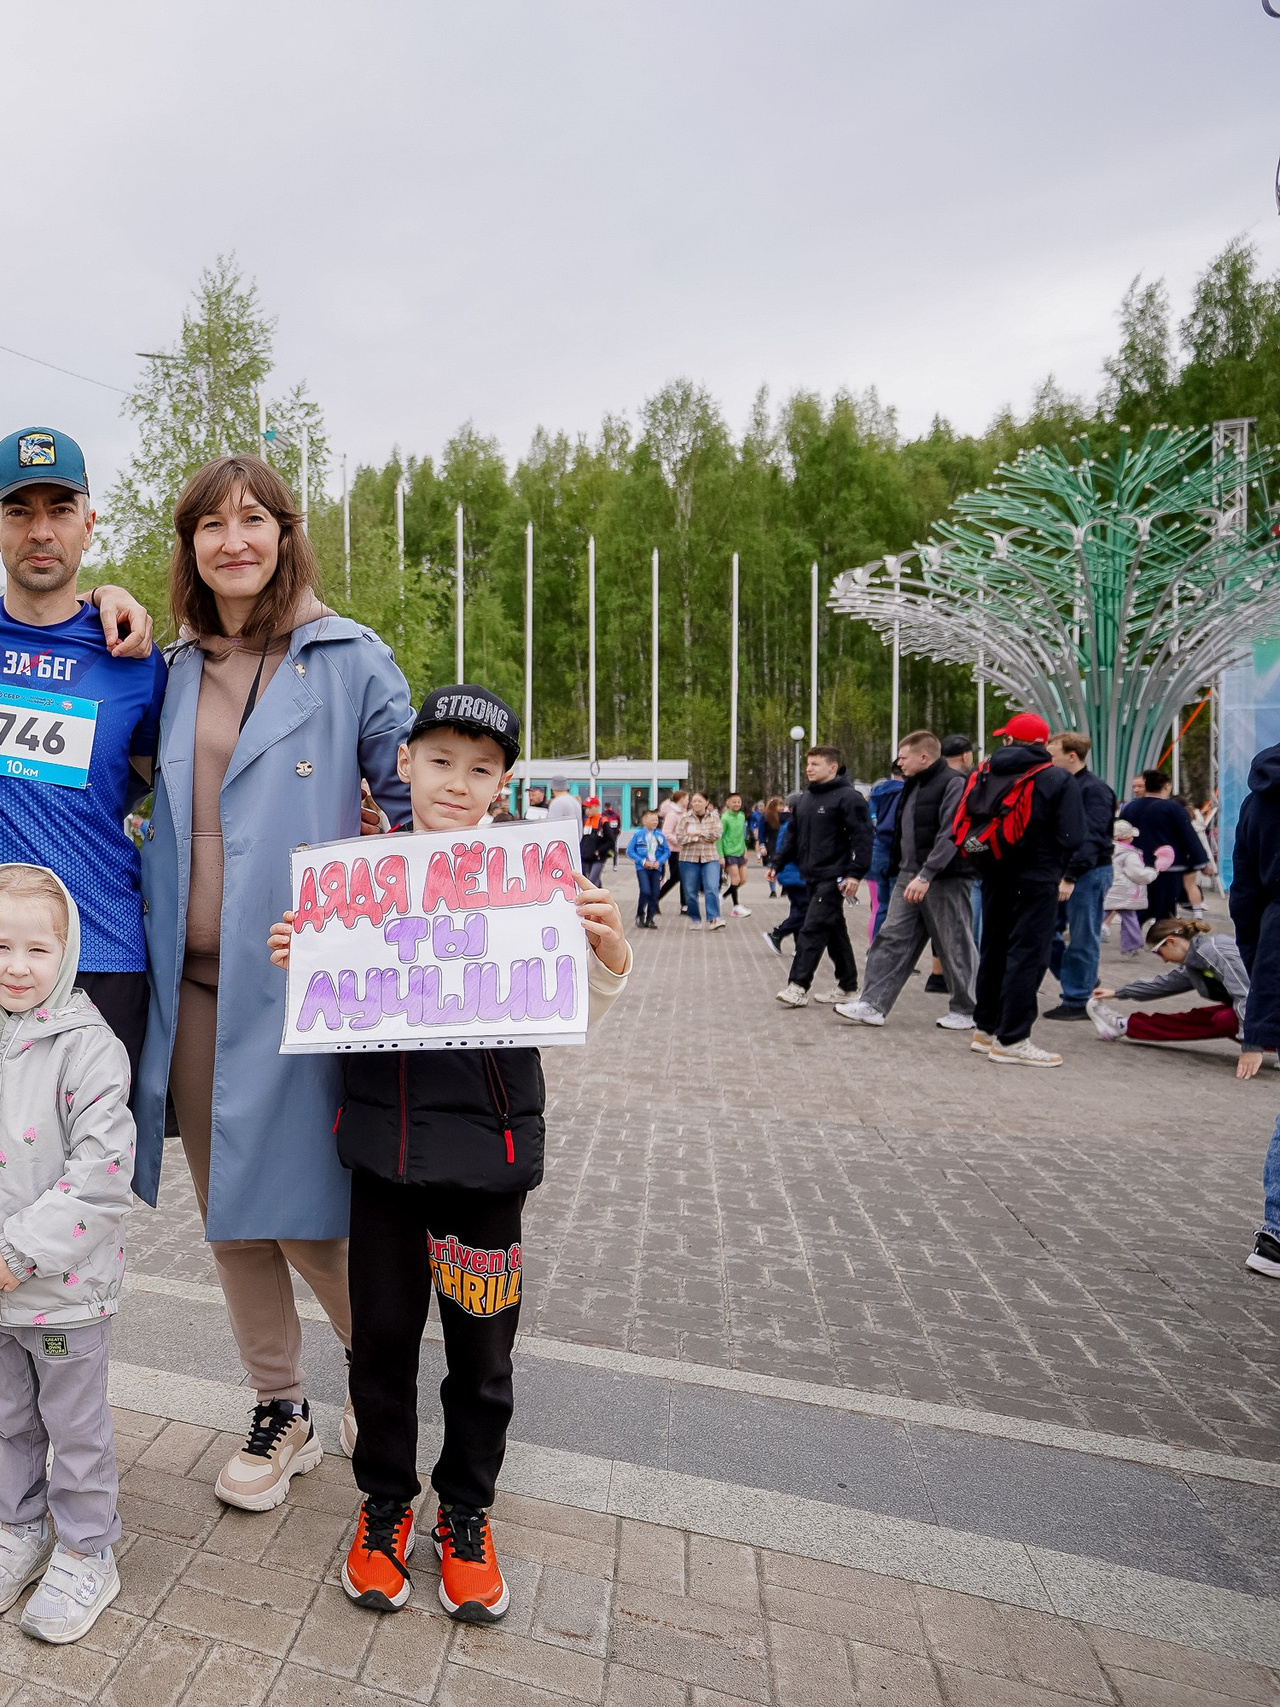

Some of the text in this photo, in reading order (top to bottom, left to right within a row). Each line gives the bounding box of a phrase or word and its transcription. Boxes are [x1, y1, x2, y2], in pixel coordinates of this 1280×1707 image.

[3, 650, 78, 681] ЗАБЕГ
[434, 694, 509, 732] STRONG
[293, 840, 580, 935] ДЯДЯ ЛЁША
[384, 913, 489, 964] ТЫ
[296, 926, 579, 1032] ЛУЧШИЙ
